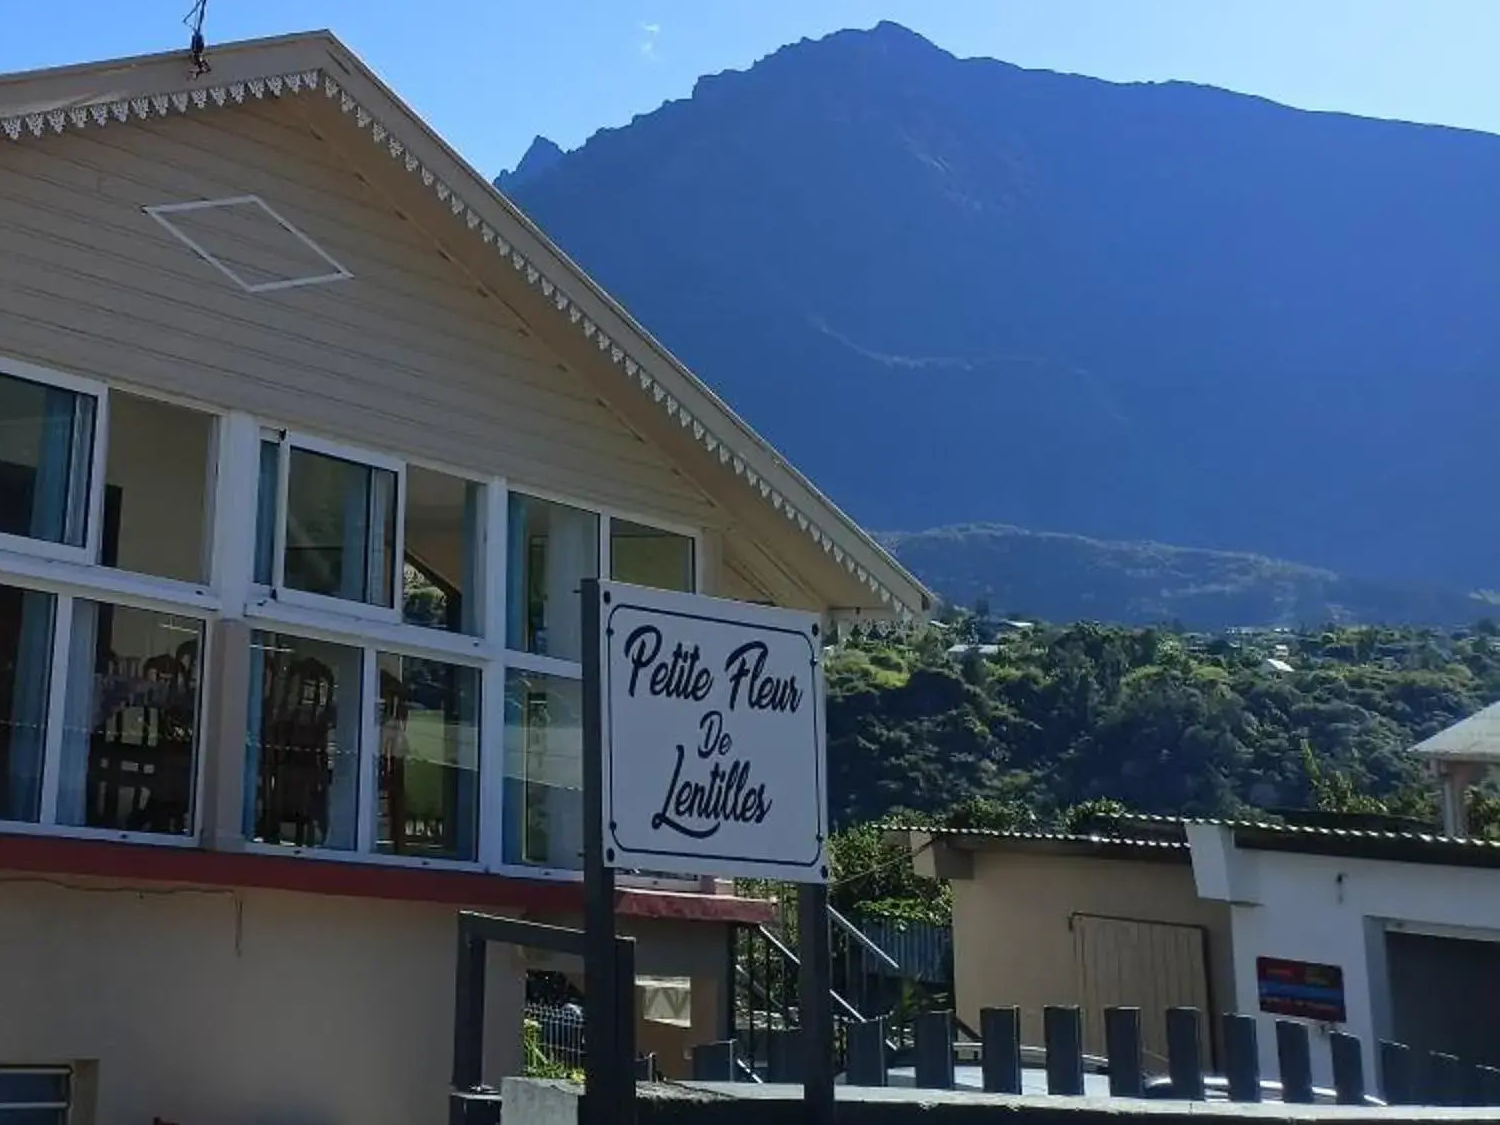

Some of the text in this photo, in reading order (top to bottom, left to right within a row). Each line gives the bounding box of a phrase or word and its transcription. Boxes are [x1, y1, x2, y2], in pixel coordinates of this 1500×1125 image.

[624, 625, 802, 713] Petite Fleur
[697, 710, 732, 759] De
[651, 744, 772, 839] Lentilles
